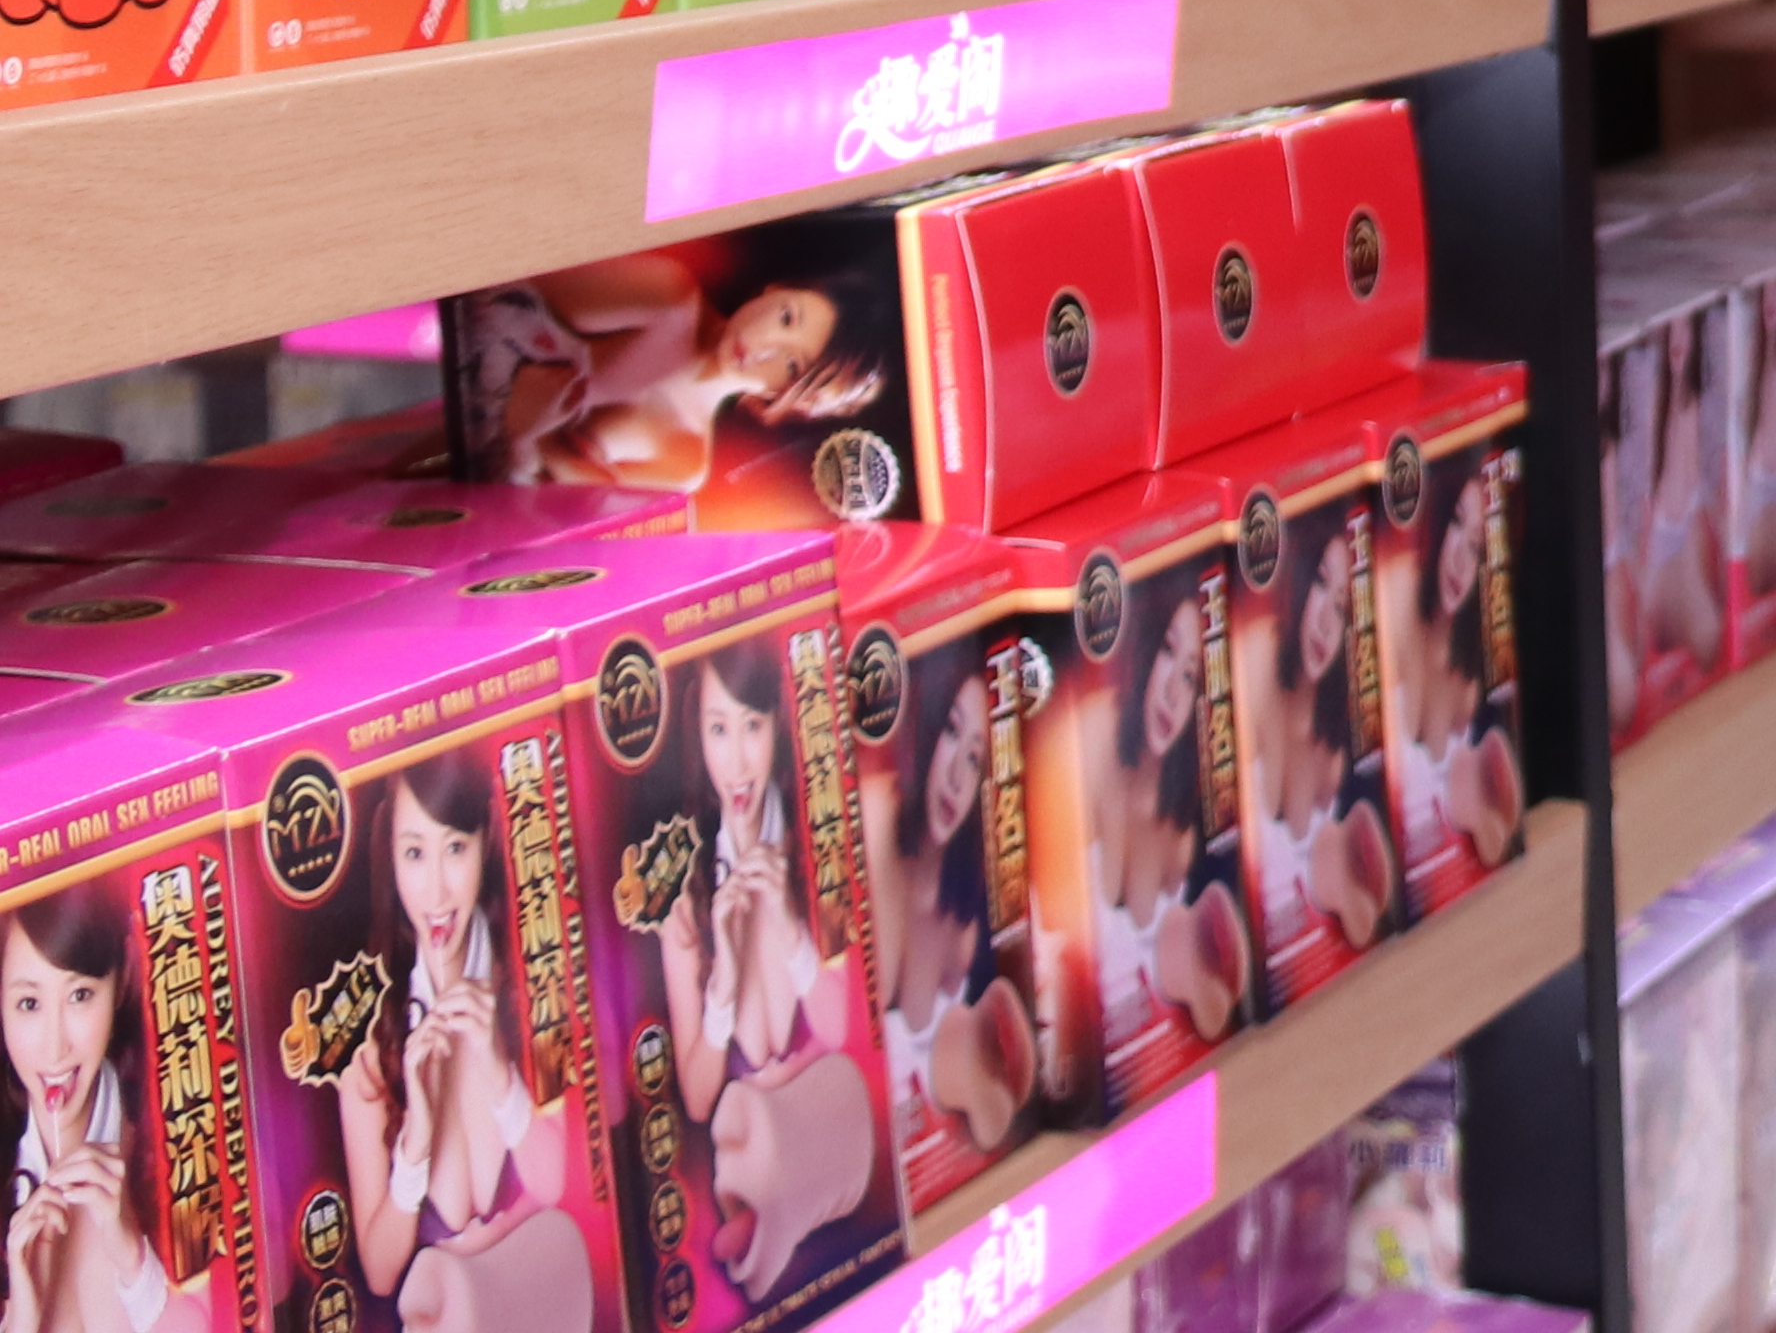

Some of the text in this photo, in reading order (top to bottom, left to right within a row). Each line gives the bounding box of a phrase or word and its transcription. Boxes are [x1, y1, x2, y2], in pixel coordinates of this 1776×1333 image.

[738, 584, 767, 609] ORAL
[439, 685, 477, 718] ORAL
[66, 806, 113, 853] ORAL
[115, 794, 150, 831] SEX
[151, 770, 220, 817] FEELING
[198, 852, 236, 1045] AUDREY
[501, 737, 578, 1105] 奥德莉深喉
[140, 867, 228, 1281] 奥德莉深喉
